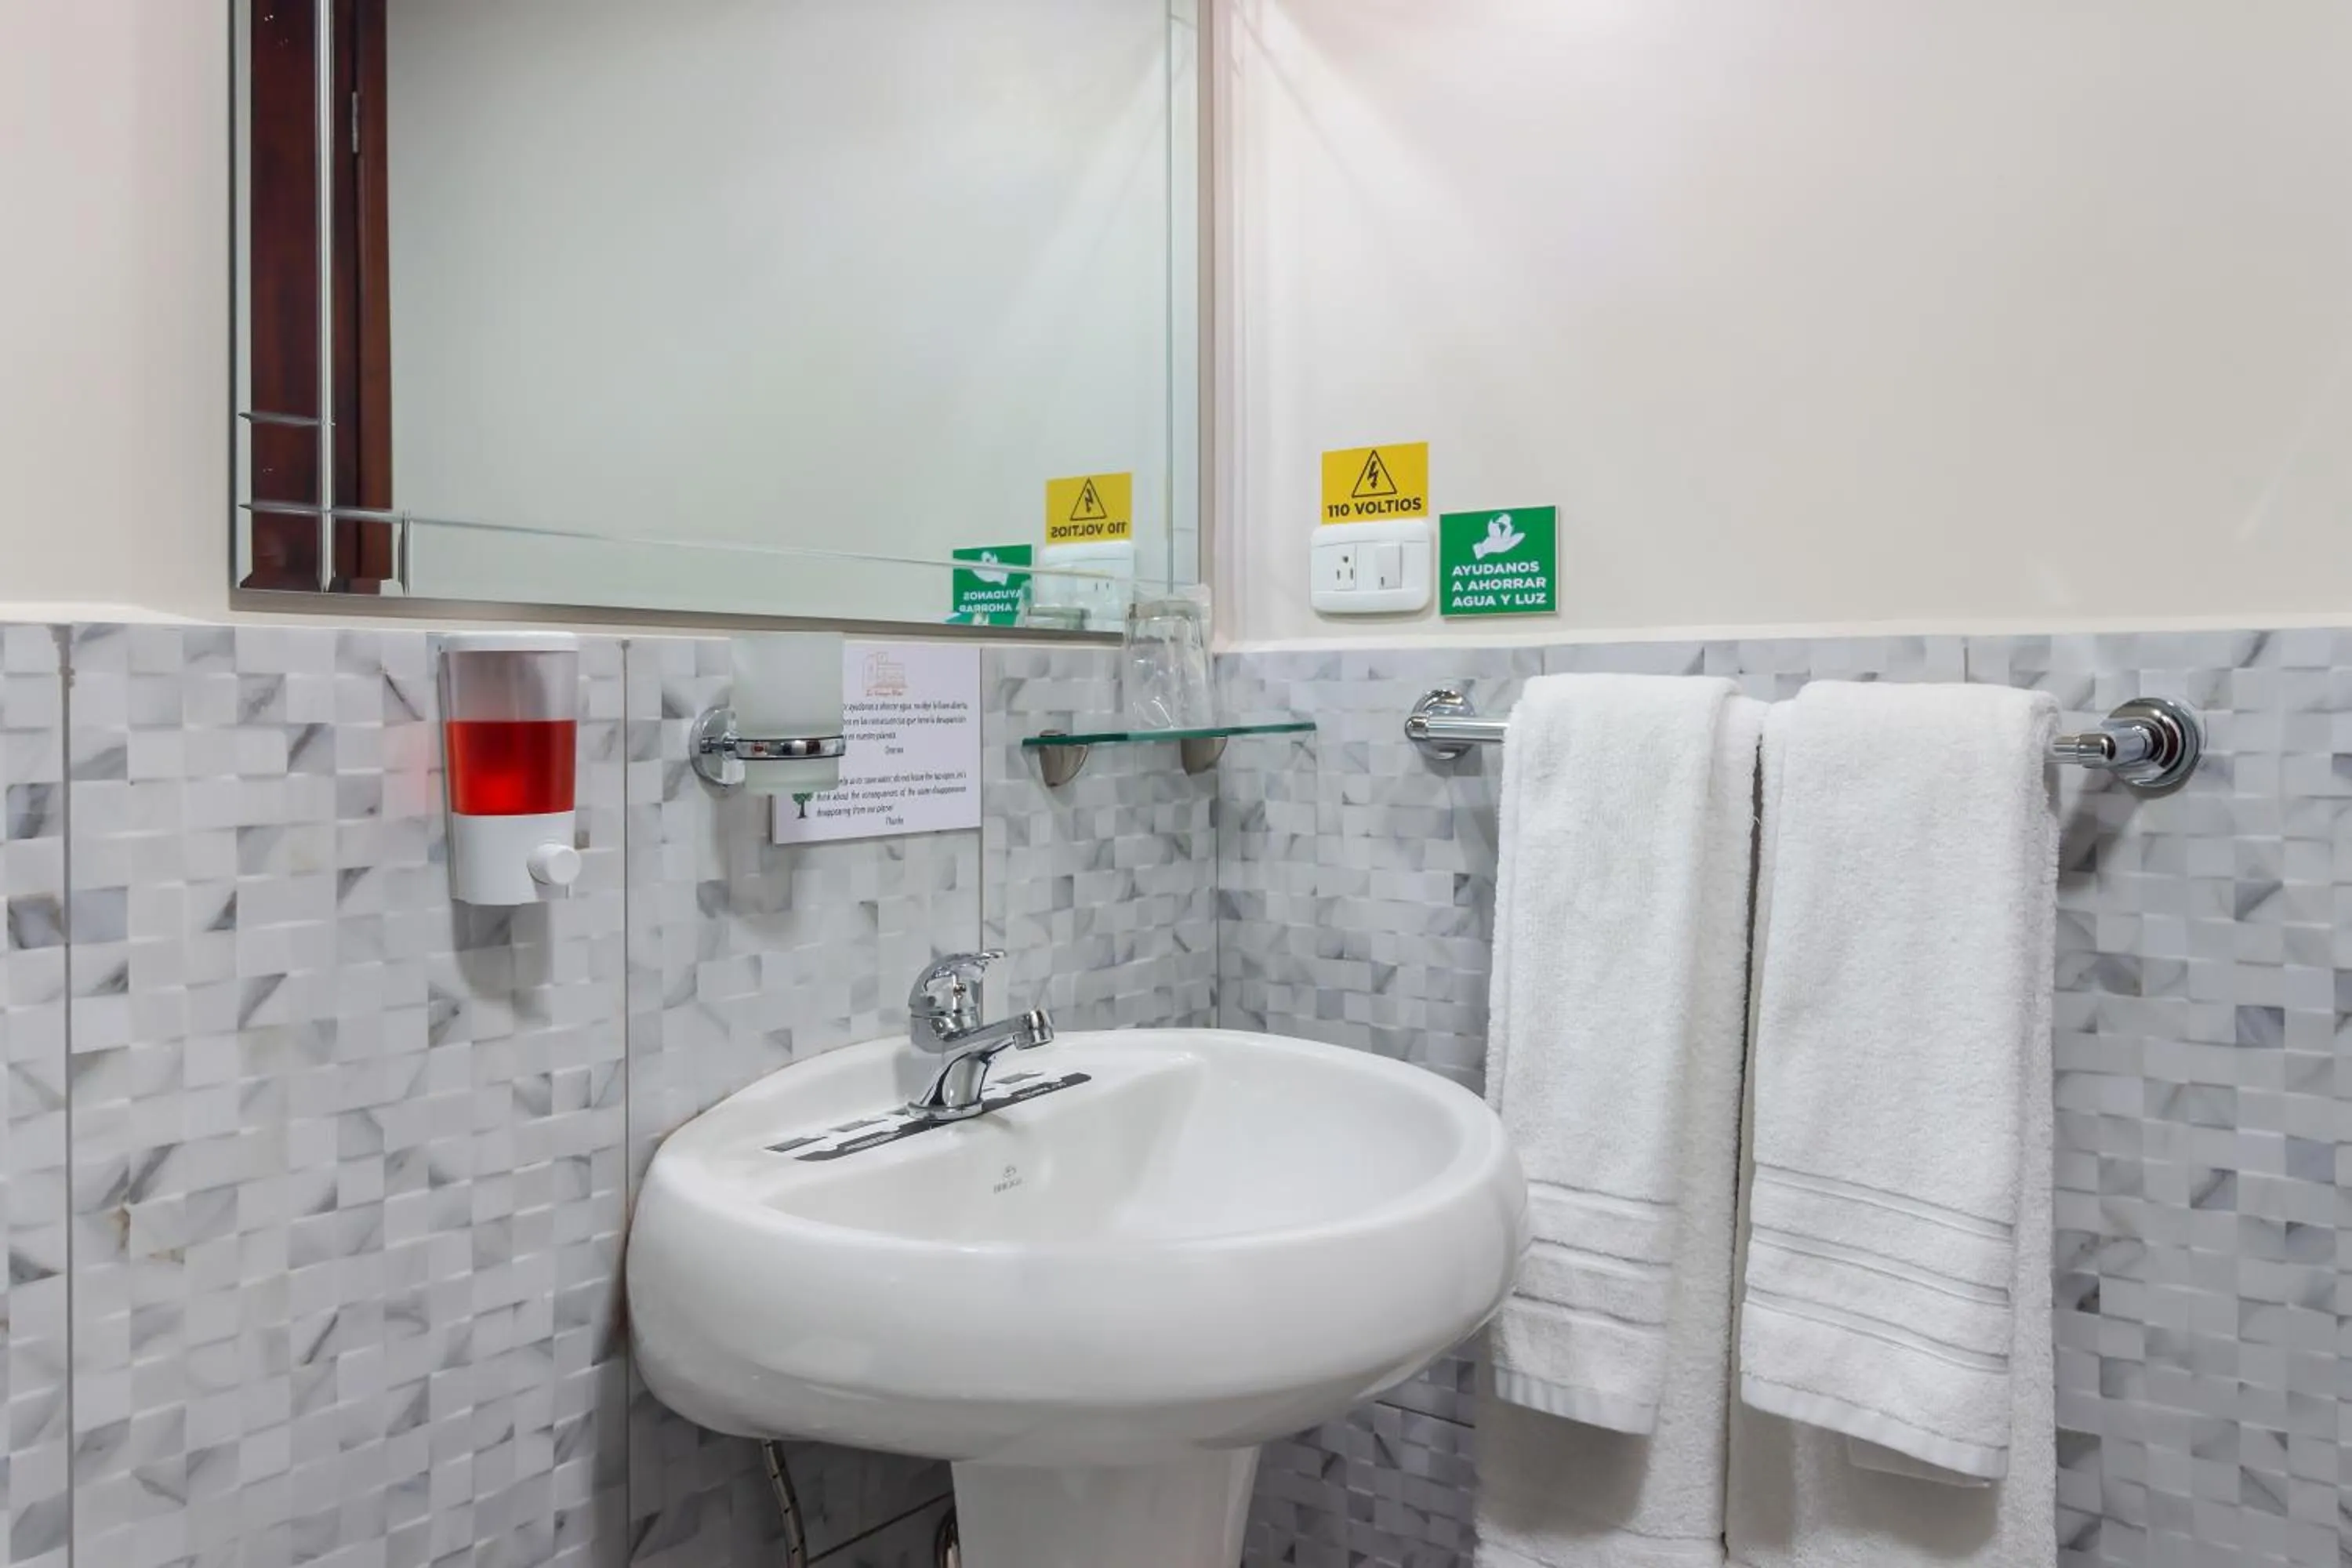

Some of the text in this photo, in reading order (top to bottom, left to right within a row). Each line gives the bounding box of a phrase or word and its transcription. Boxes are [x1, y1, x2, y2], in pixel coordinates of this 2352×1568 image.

[1327, 497, 1422, 517] 110 VOLTIOS
[1452, 561, 1540, 577] AYUDANOS
[1452, 577, 1548, 592] A AHORRAR
[1452, 592, 1548, 608] AGUA Y LUZ
